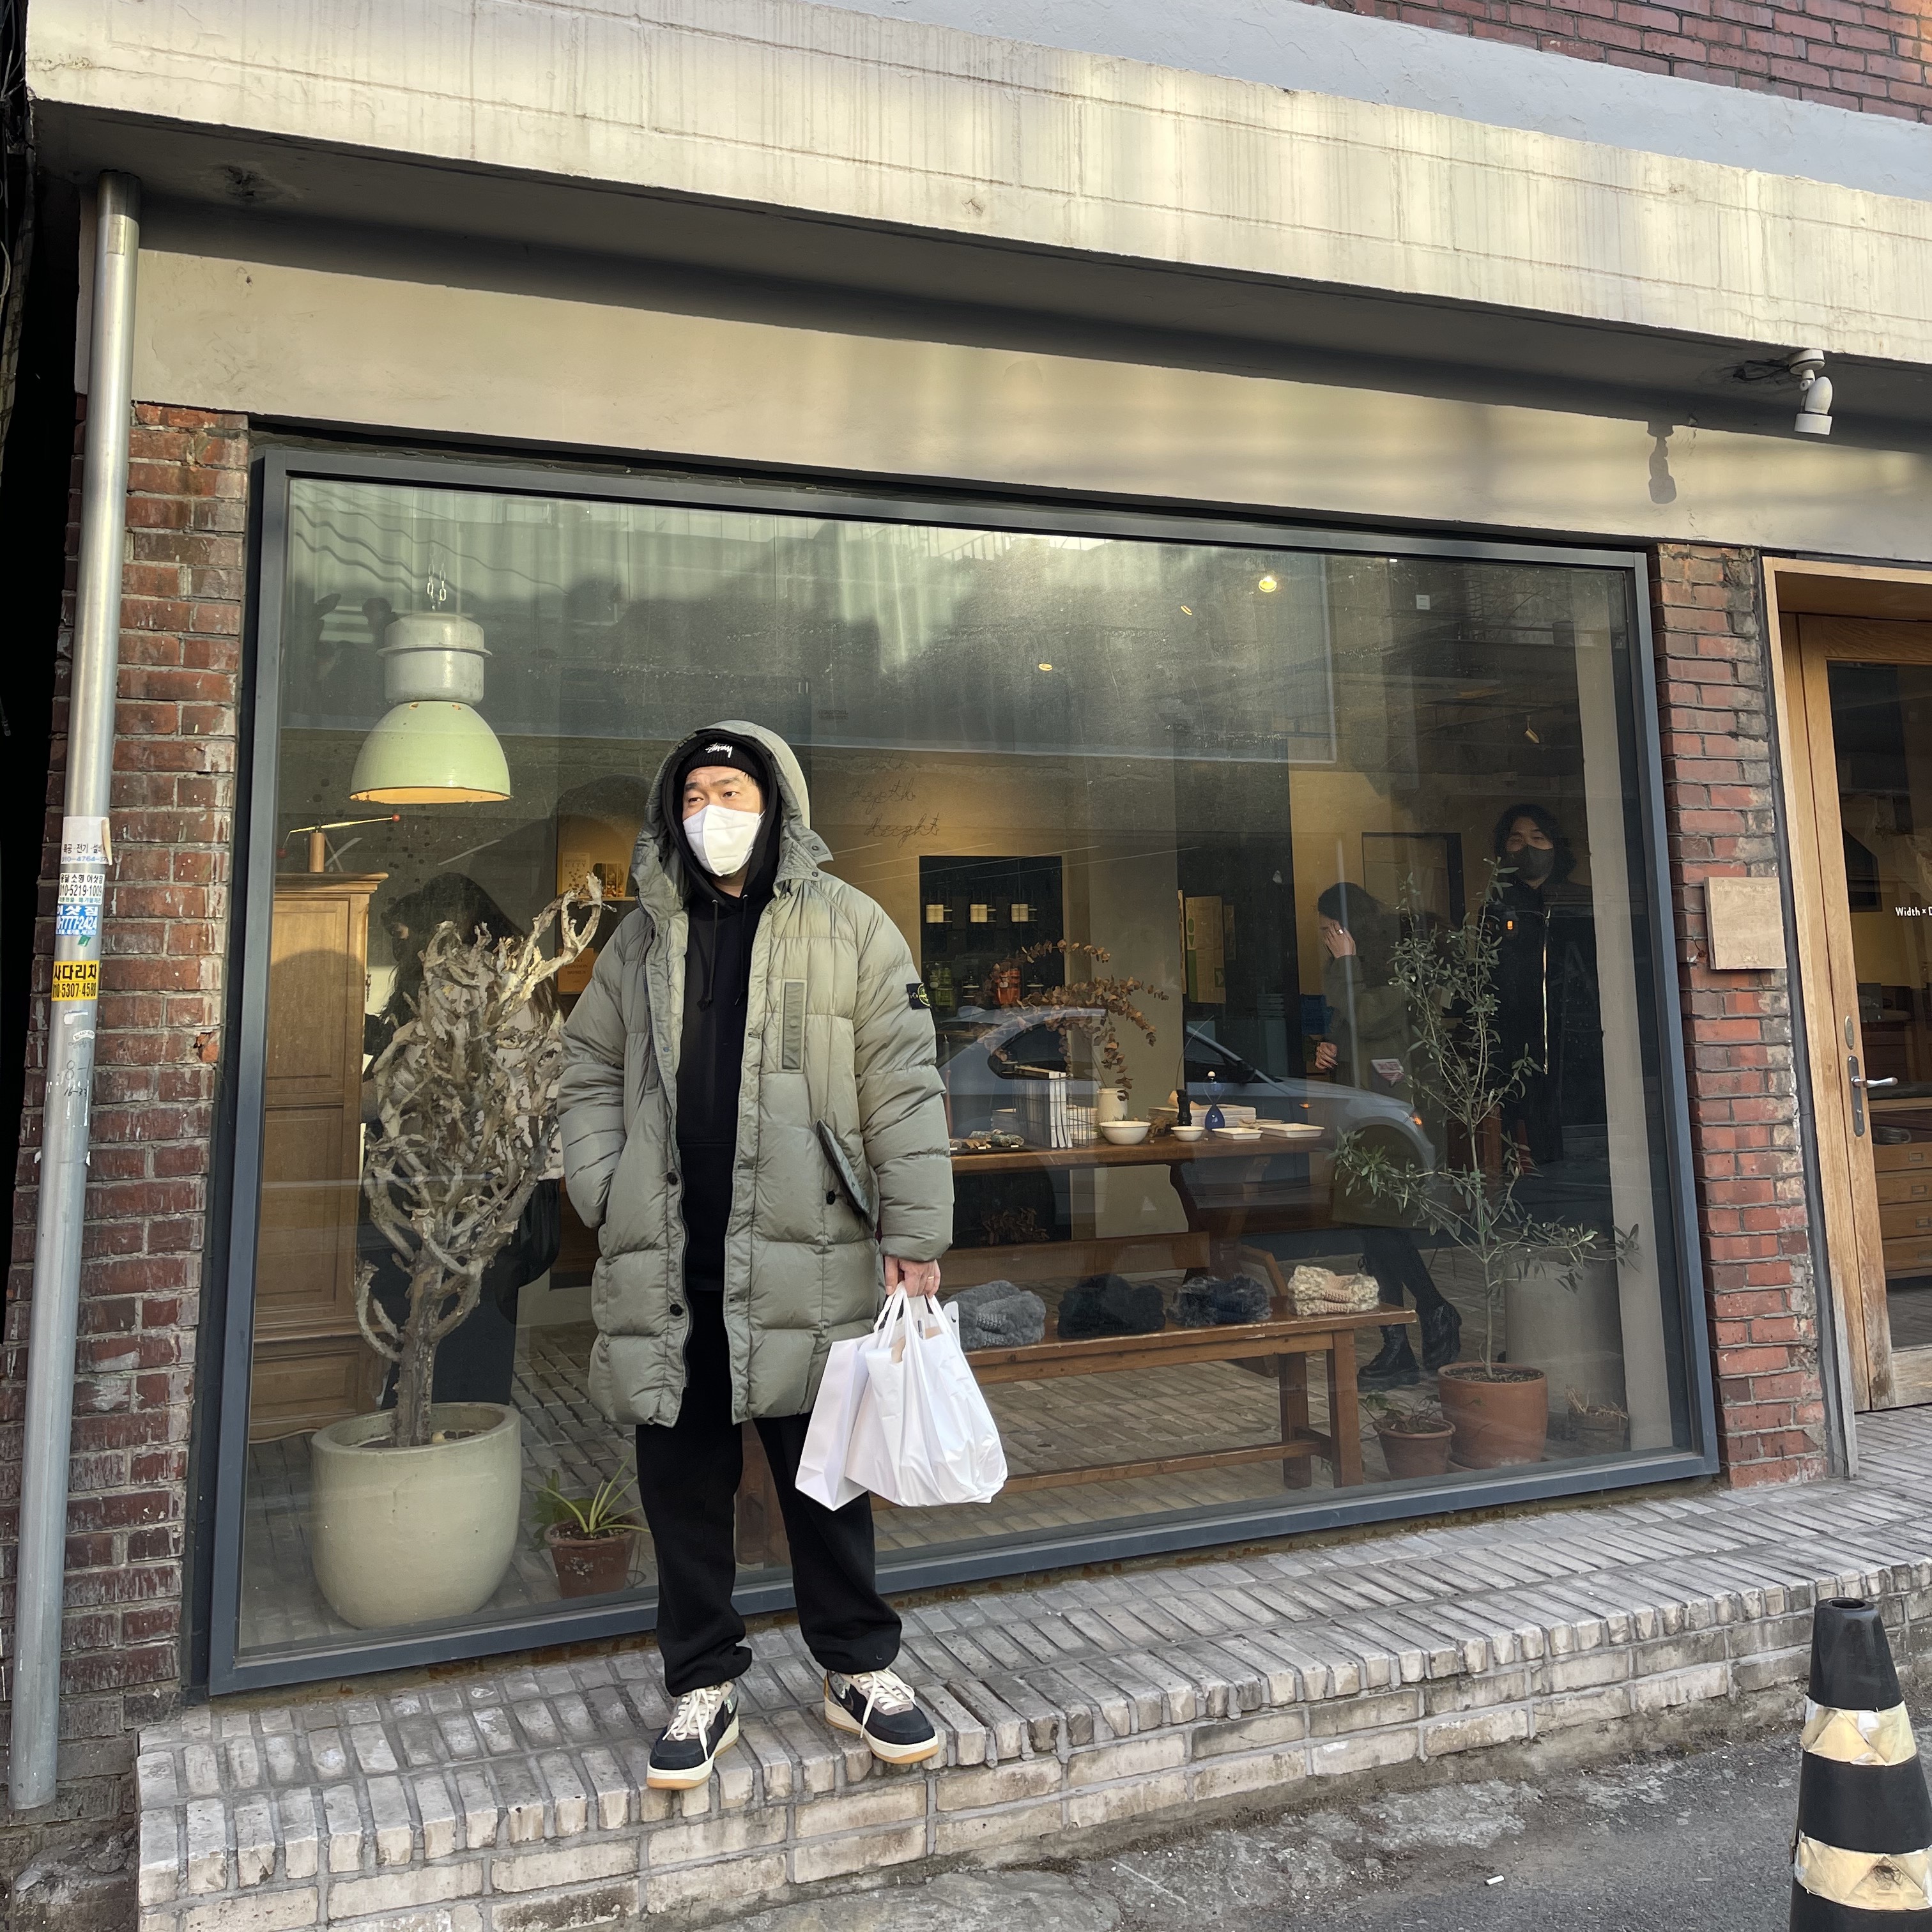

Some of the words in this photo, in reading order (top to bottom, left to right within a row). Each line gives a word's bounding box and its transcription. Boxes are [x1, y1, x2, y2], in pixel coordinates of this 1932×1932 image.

[864, 812, 940, 848] height
[1895, 907, 1920, 916] Width
[54, 963, 97, 981] 사다리차
